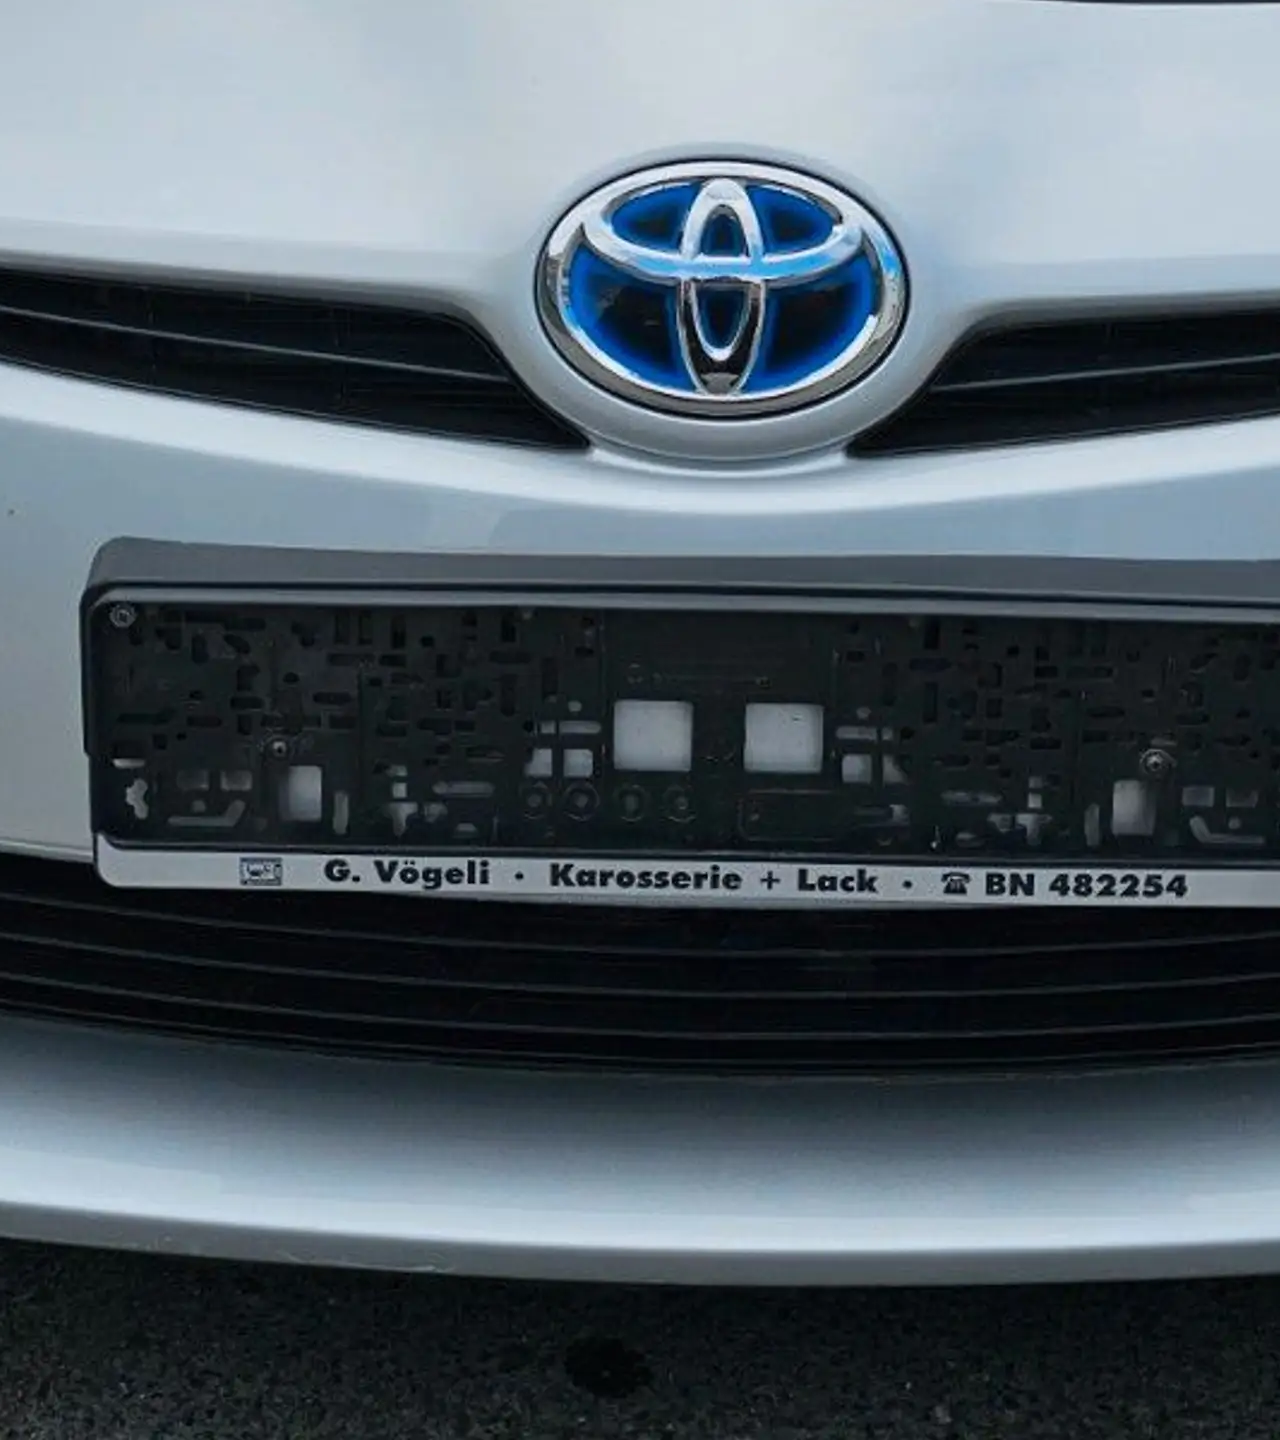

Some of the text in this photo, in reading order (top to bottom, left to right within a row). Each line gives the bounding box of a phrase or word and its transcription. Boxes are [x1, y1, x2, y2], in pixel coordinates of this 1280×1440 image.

[323, 858, 361, 884] G.
[373, 859, 490, 892] Vögeli
[549, 862, 743, 891] Karosserie
[797, 868, 878, 894] Lack
[985, 872, 1035, 897] BN
[1048, 873, 1188, 898] 482254
